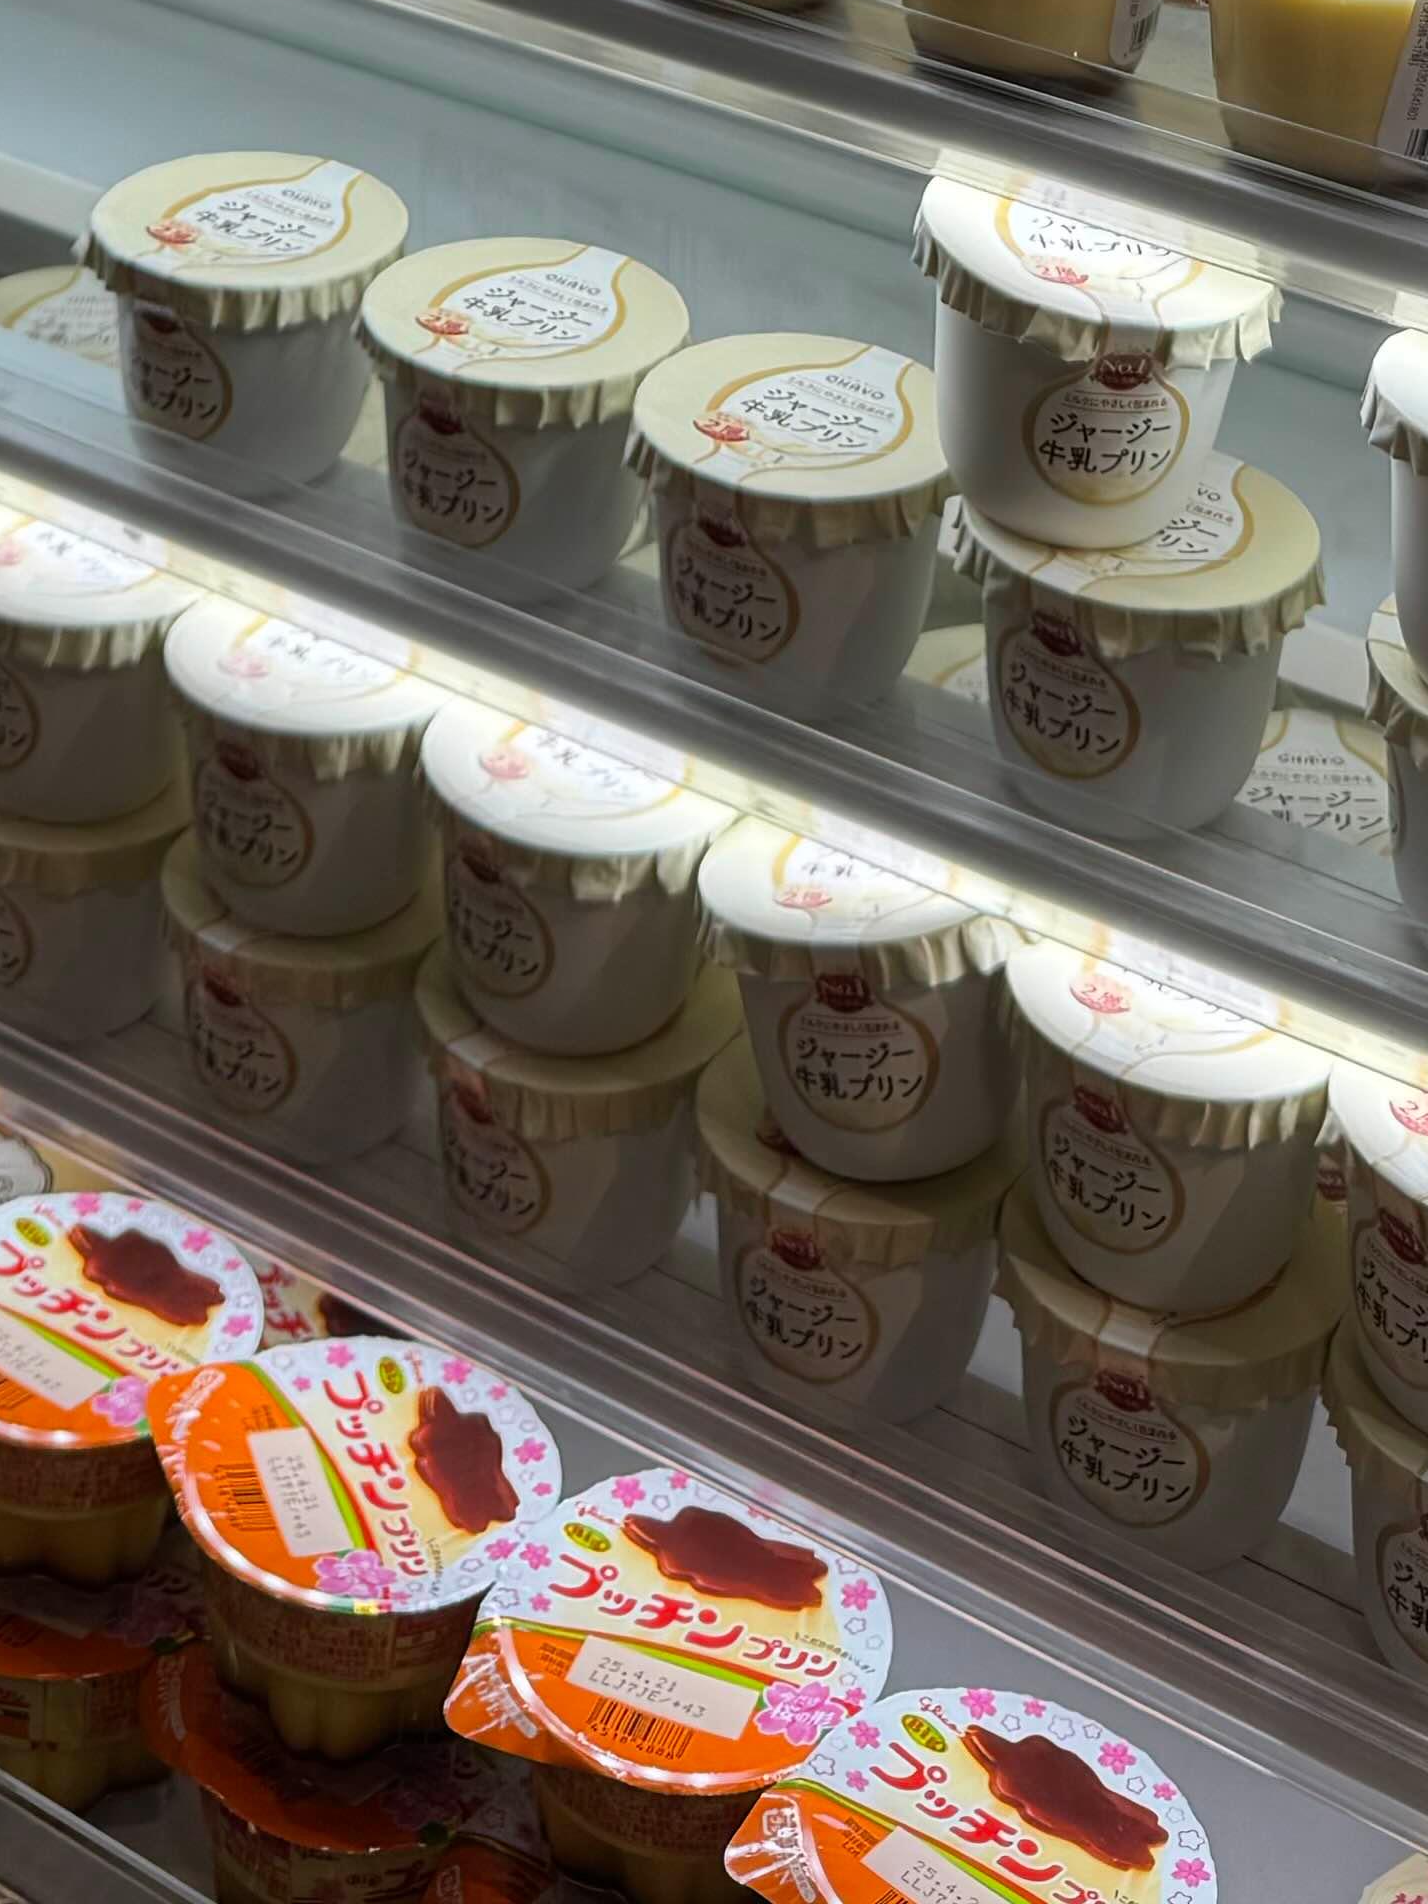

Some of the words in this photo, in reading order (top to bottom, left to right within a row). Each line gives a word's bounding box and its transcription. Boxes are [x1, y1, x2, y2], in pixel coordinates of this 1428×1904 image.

[741, 397, 871, 452] 牛乳プリン
[762, 385, 882, 437] ジャージー
[1048, 410, 1172, 445] ジャージー
[1037, 440, 1175, 477] 牛乳プリン
[793, 1034, 919, 1071] ジャージー
[791, 1063, 926, 1106] 牛乳プリン
[1048, 1132, 1165, 1202] ジャージー
[1044, 1162, 1169, 1237] 牛乳プリン
[1064, 1413, 1197, 1472] ジャージー
[321, 1366, 411, 1510] プッチン
[384, 1516, 430, 1580] プリン
[1055, 1439, 1198, 1507] 牛乳プリン
[548, 1552, 745, 1650] プッチン
[740, 1634, 840, 1679] プリン
[596, 1655, 678, 1695] 25.4.21
[869, 1739, 1064, 1885] プッチン
